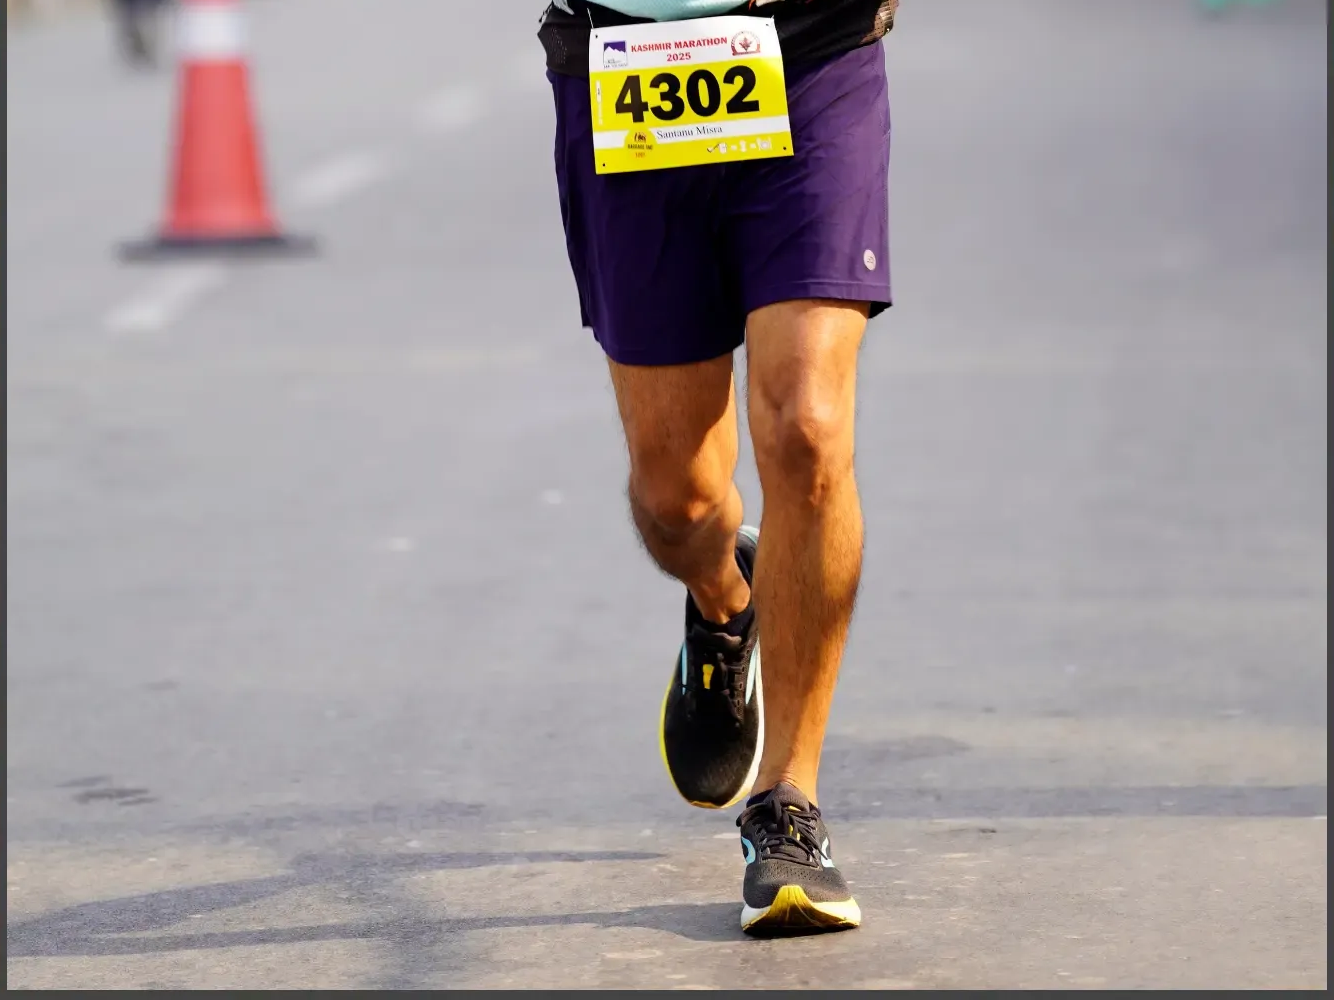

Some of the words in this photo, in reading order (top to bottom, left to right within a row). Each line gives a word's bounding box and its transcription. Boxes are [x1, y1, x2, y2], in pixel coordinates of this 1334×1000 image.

[631, 42, 672, 53] KASHMIR
[674, 36, 728, 50] MARATHON
[666, 52, 692, 62] 2025
[615, 64, 760, 124] 4302
[656, 127, 694, 140] Santanu
[695, 123, 723, 135] Misra
